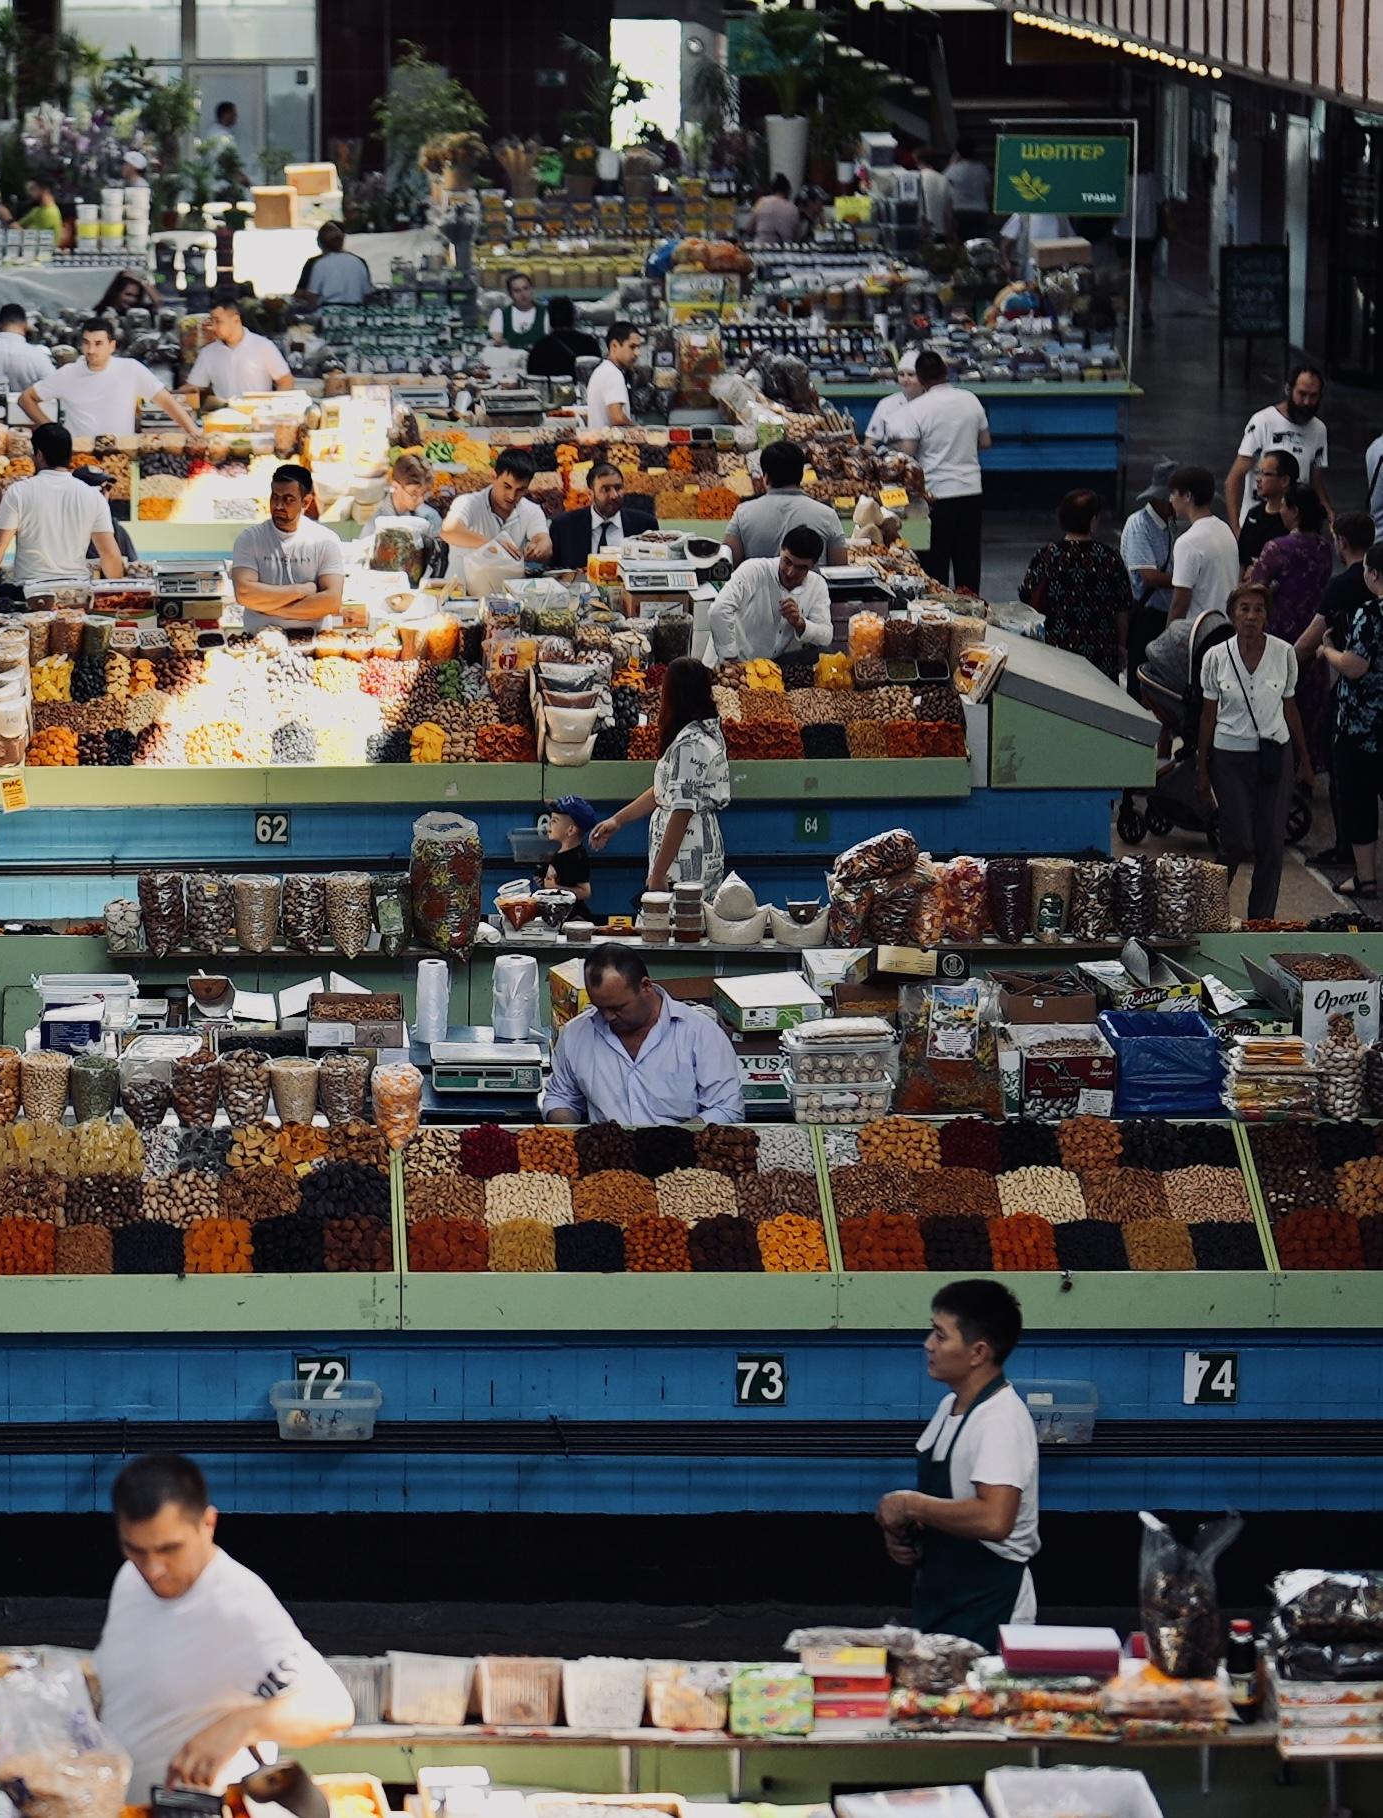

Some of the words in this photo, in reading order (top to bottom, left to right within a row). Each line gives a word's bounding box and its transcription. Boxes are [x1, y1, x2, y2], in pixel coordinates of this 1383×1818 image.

[1021, 143, 1104, 159] ШӨПТЕР
[1081, 192, 1116, 202] ТРАВЫ
[2, 780, 21, 789] РИС
[257, 815, 287, 842] 62
[537, 813, 552, 840] 6
[804, 816, 818, 833] 64
[1314, 989, 1369, 1014] Орехи
[298, 1361, 345, 1400] 72
[737, 1361, 783, 1400] 73
[1193, 1359, 1235, 1398] 74
